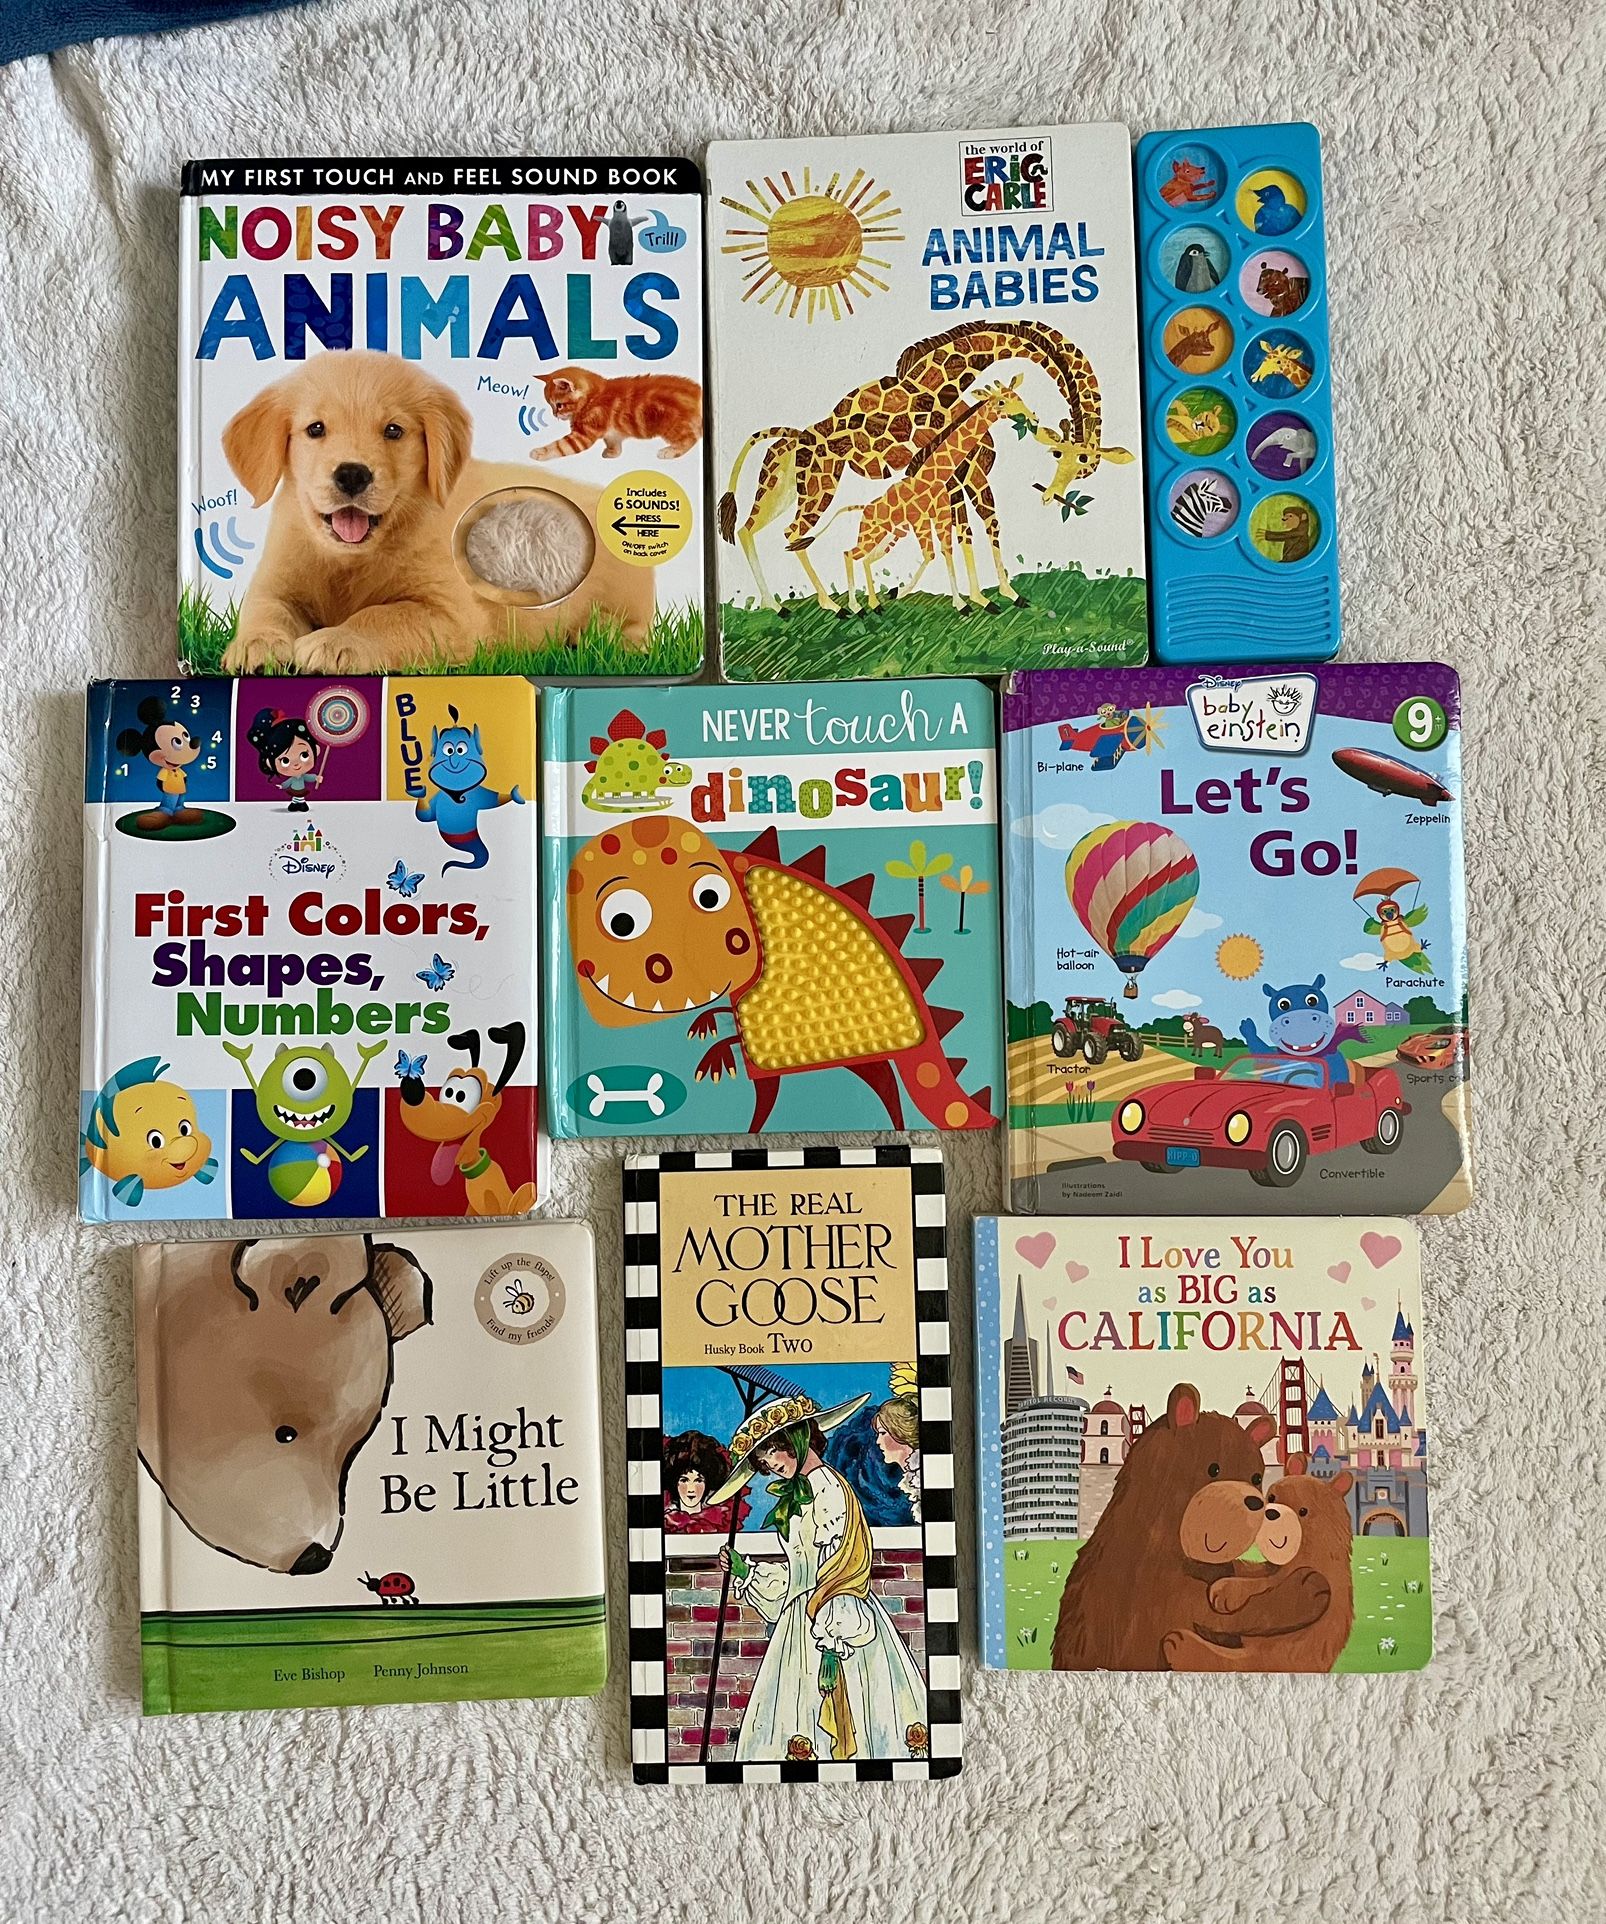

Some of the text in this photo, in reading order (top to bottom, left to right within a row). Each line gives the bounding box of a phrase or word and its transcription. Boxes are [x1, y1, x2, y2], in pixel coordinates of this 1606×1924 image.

[965, 140, 1044, 155] the world of
[201, 168, 678, 187] MY FIRST TOUCH AND FEEL SOUND BOOK
[964, 181, 1046, 212] CARLE
[199, 203, 608, 262] NOISY BABY
[921, 222, 1105, 267] ANIMAL
[930, 265, 1099, 311] BABIES
[195, 272, 680, 360] ANIMALS
[477, 375, 529, 400] Meow!
[193, 489, 238, 516] Woof!
[613, 497, 680, 511] 6 SOUNDS!
[627, 488, 667, 497] Includes
[635, 514, 661, 523] PRESS
[622, 540, 669, 550] ON/OFF switch
[637, 529, 659, 537] HERE
[633, 549, 648, 557] back
[650, 549, 667, 557] cover
[170, 685, 181, 699] 2
[190, 695, 200, 708] 3
[702, 689, 969, 746] NEVER touch A
[1203, 693, 1254, 724] baby
[211, 730, 223, 744] 4
[395, 693, 426, 793] BLUE
[120, 764, 128, 777] 1
[206, 756, 217, 770] 5
[1037, 761, 1084, 774] Bi-plane
[690, 760, 985, 823] dinosaur!
[1160, 767, 1311, 815] Let's
[1405, 813, 1451, 826] Zeppelin
[1249, 829, 1358, 878] Go!
[134, 888, 491, 941] First Colors,
[1056, 947, 1100, 960] Hot-air
[1056, 960, 1095, 971] balloon
[152, 939, 385, 998] Shapes,
[1385, 976, 1445, 990] Parachute
[176, 987, 451, 1037] Numbers
[1046, 1064, 1091, 1075] Tractor
[1406, 1073, 1445, 1085] Sports
[1319, 1168, 1385, 1180] Convertible
[714, 1192, 863, 1217] THE REAL
[1062, 1191, 1071, 1199] by
[672, 1223, 898, 1273] MOTHER
[1117, 1236, 1294, 1269] I Love You
[484, 1257, 556, 1285] Lift up the flaps!
[695, 1275, 886, 1328] GOOSE
[1138, 1274, 1276, 1304] as BIG as
[486, 1315, 556, 1343] Find my friends!
[1057, 1310, 1363, 1352] CALIFORNIA
[704, 1333, 813, 1356] Husky Book Two
[391, 1406, 565, 1469] I Might
[379, 1462, 579, 1515] Be Little
[273, 1666, 346, 1685] Eve Bishop
[373, 1661, 469, 1681] Penny Johnson
